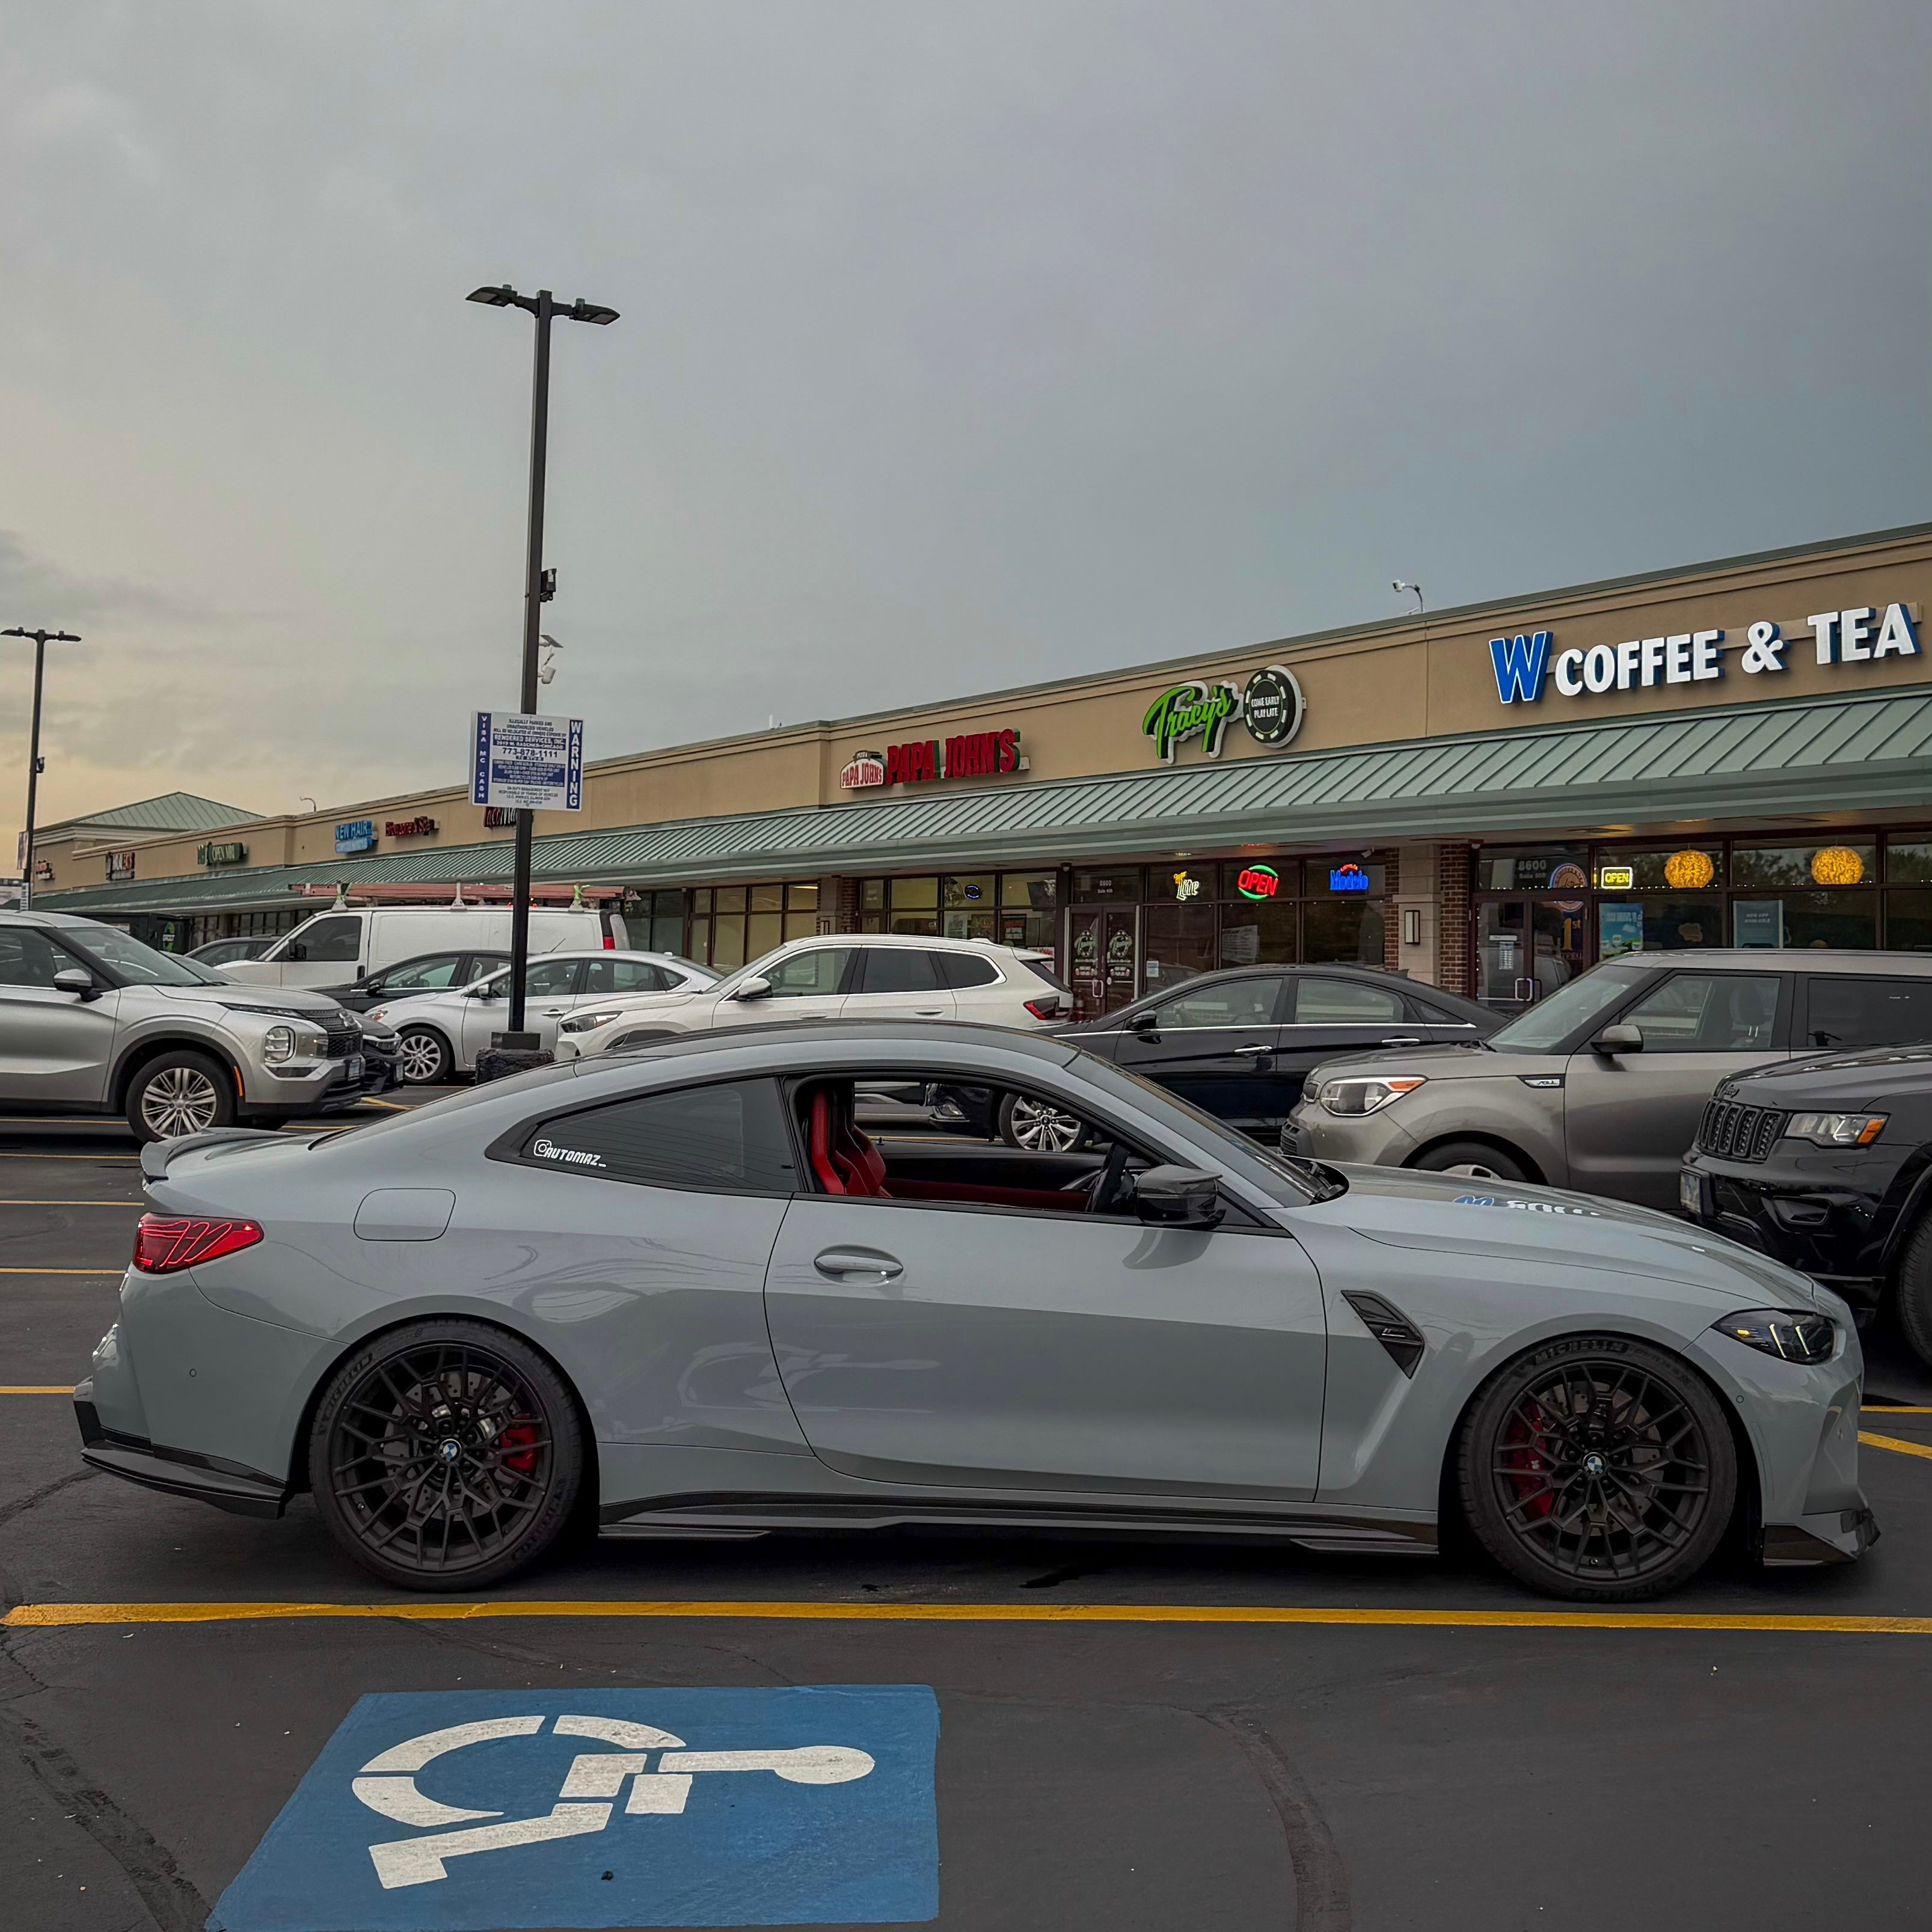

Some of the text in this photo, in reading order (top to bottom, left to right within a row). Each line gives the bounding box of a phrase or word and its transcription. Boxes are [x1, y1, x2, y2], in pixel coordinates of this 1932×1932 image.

[1489, 603, 1915, 704] W COFFEE & TEA
[1251, 696, 1280, 707] COME EARLY
[1142, 685, 1234, 759] Tracy's
[1254, 708, 1278, 719] PLAY LATE
[502, 747, 557, 758] 773-878-1111
[569, 721, 581, 806] WARNING
[887, 728, 1017, 785] PAPA JOHN'S
[842, 764, 859, 787] PAPA
[336, 824, 349, 839] NEW
[351, 821, 367, 837] HAIR
[1518, 860, 1546, 871] 8600
[1238, 869, 1278, 896] OPEN
[1604, 872, 1629, 883] OPEN
[1535, 1339, 1625, 1365] MICHELIN
